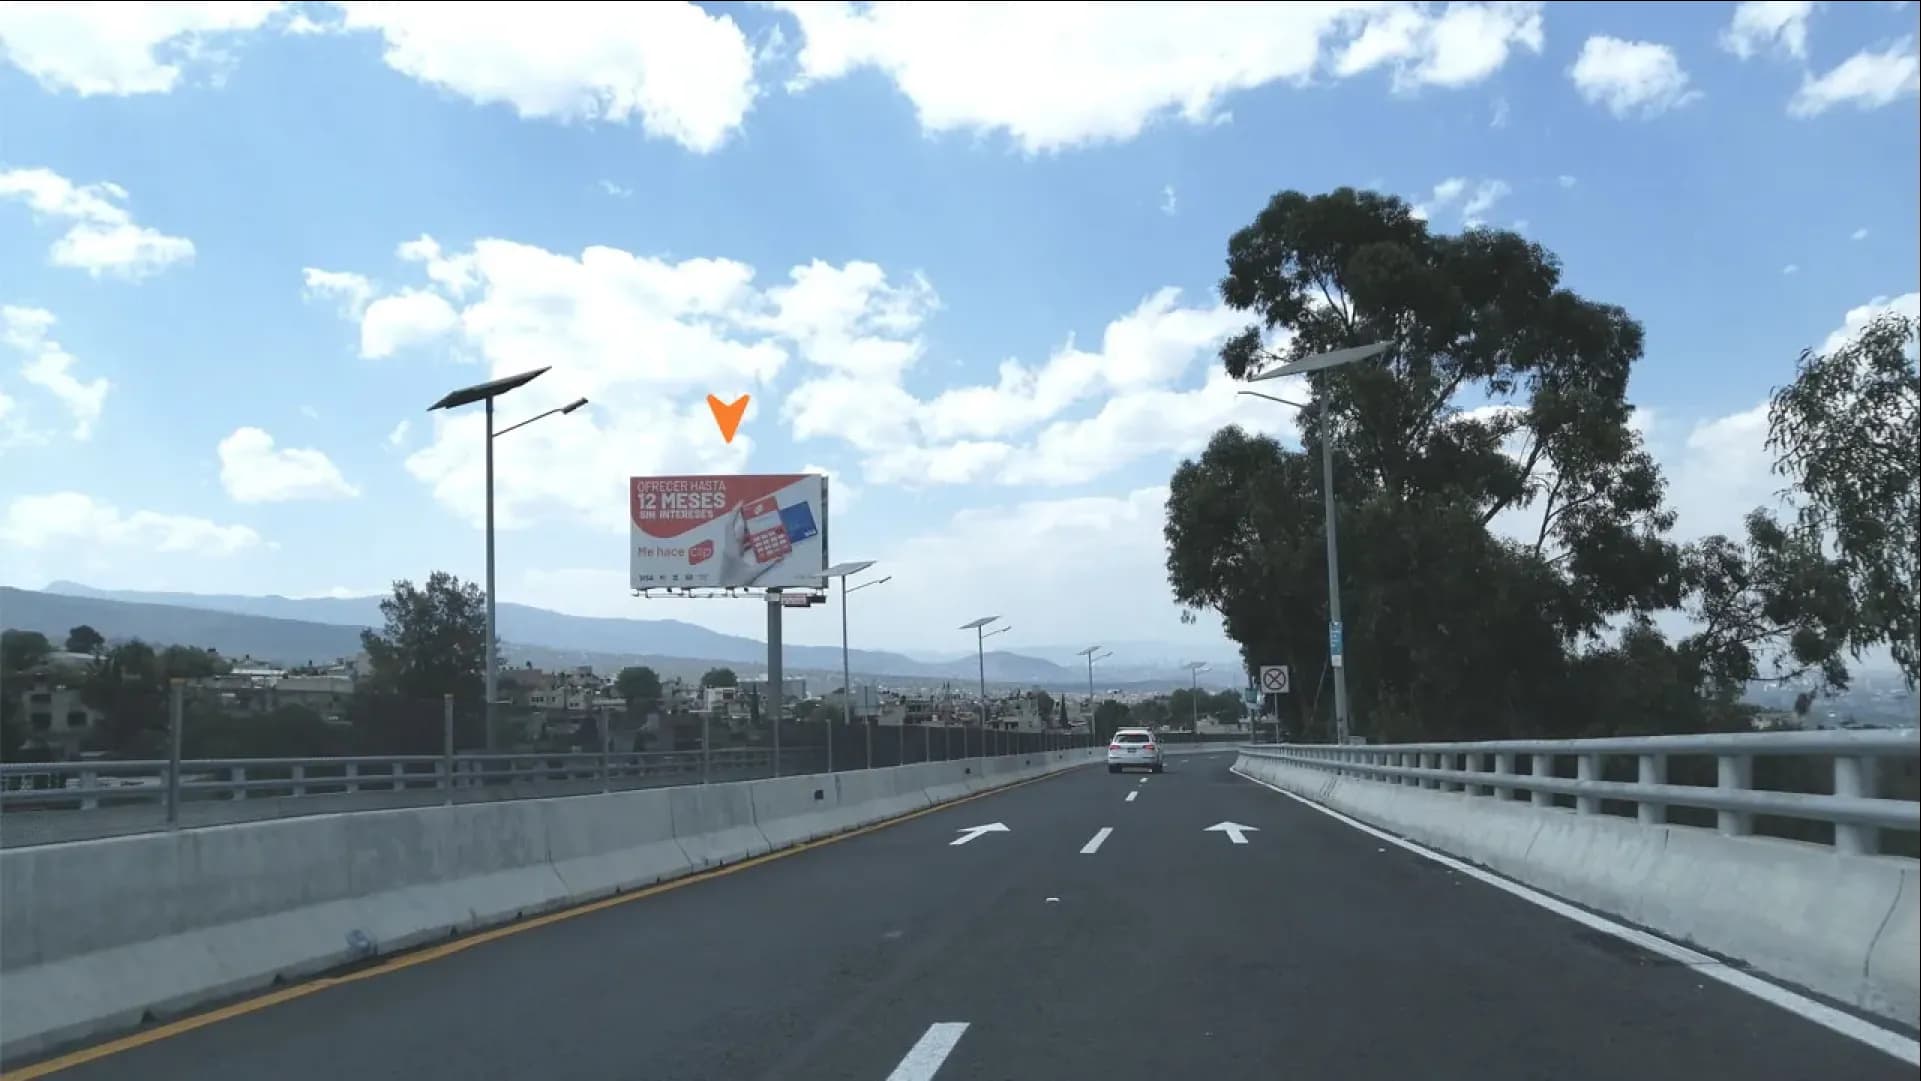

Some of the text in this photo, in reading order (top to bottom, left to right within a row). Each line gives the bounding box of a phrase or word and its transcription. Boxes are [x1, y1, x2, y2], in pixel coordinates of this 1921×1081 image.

[637, 480, 726, 492] OFRECER HASTA
[638, 493, 726, 509] 12 MESES
[640, 510, 714, 520] SIN INTERESES
[638, 544, 685, 558] Me hace
